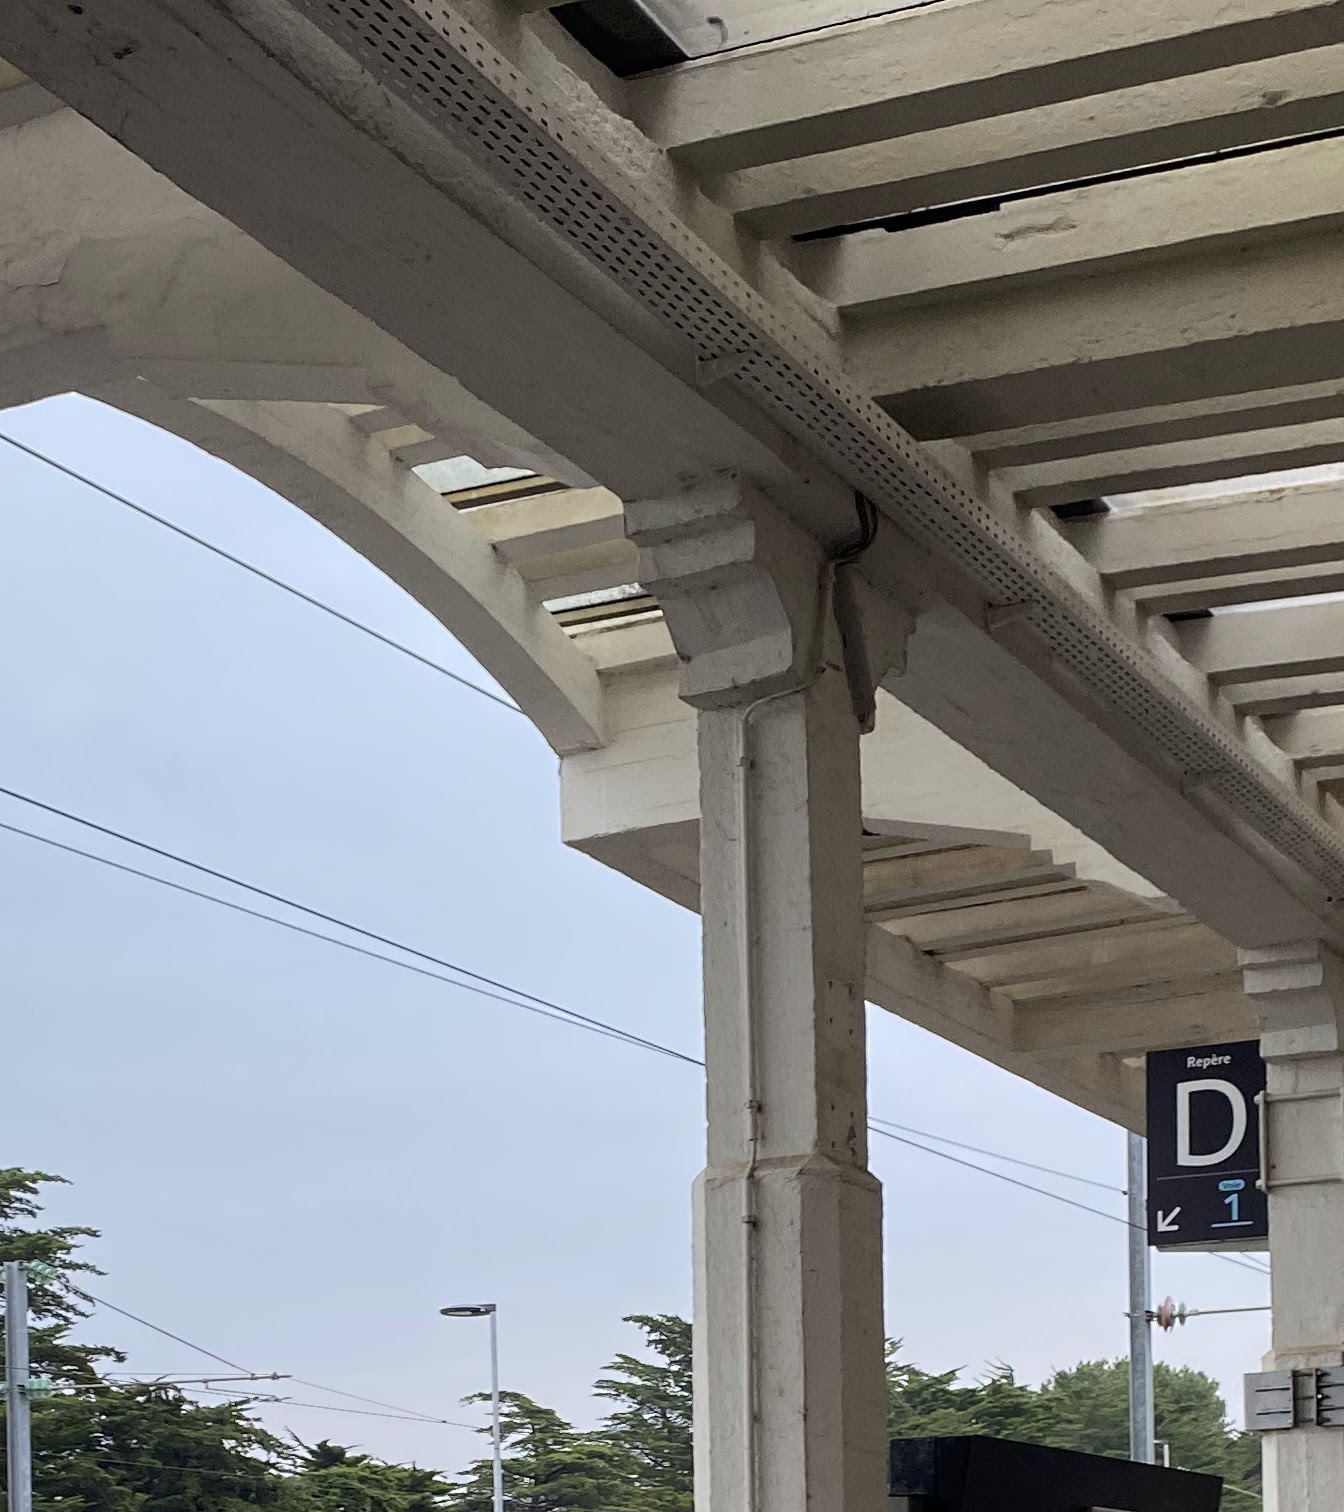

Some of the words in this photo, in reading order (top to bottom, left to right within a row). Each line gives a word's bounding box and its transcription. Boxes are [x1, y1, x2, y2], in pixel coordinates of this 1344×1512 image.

[1186, 1053, 1232, 1069] Repère
[1176, 1078, 1248, 1167] D
[1223, 1193, 1240, 1221] 1
